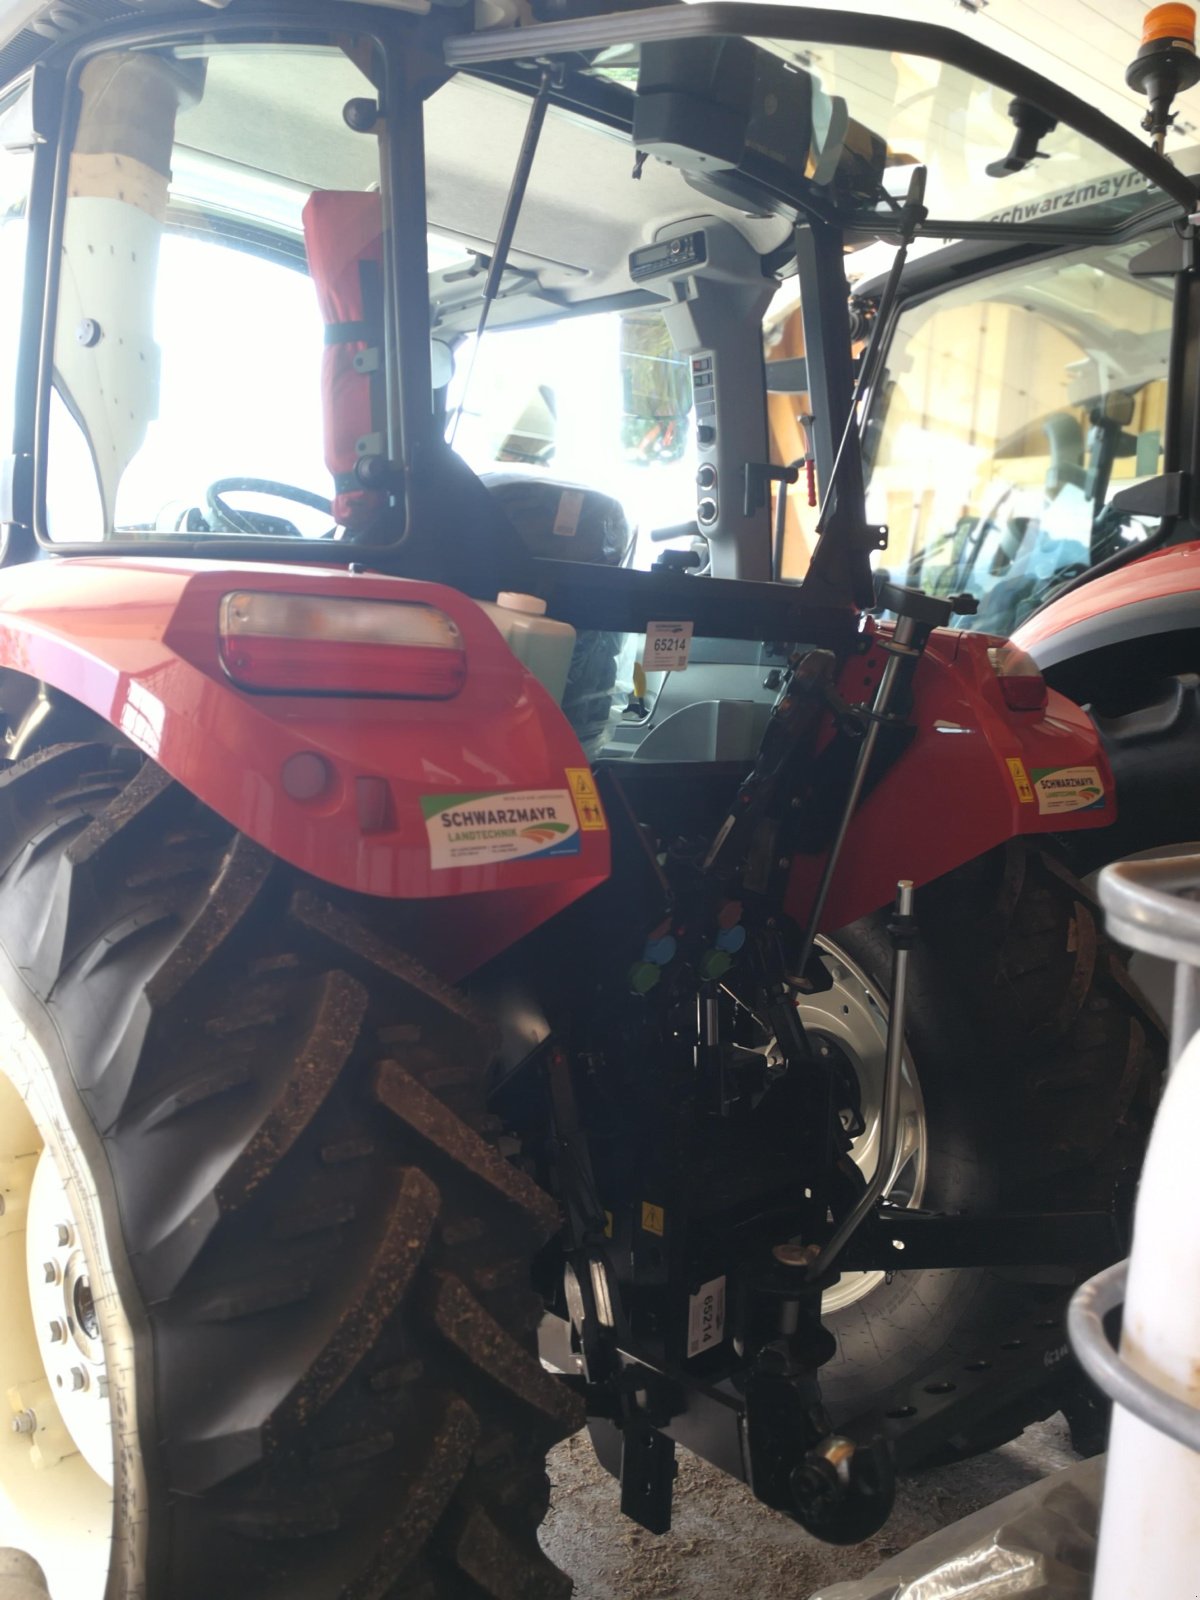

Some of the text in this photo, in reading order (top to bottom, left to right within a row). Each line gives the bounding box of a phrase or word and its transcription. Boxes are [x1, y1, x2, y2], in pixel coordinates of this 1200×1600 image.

[655, 638, 686, 651] 65214
[441, 807, 557, 827] SCHWARZMAYR
[448, 828, 518, 842] LANDTECHNIK
[703, 1295, 713, 1343] 65214
